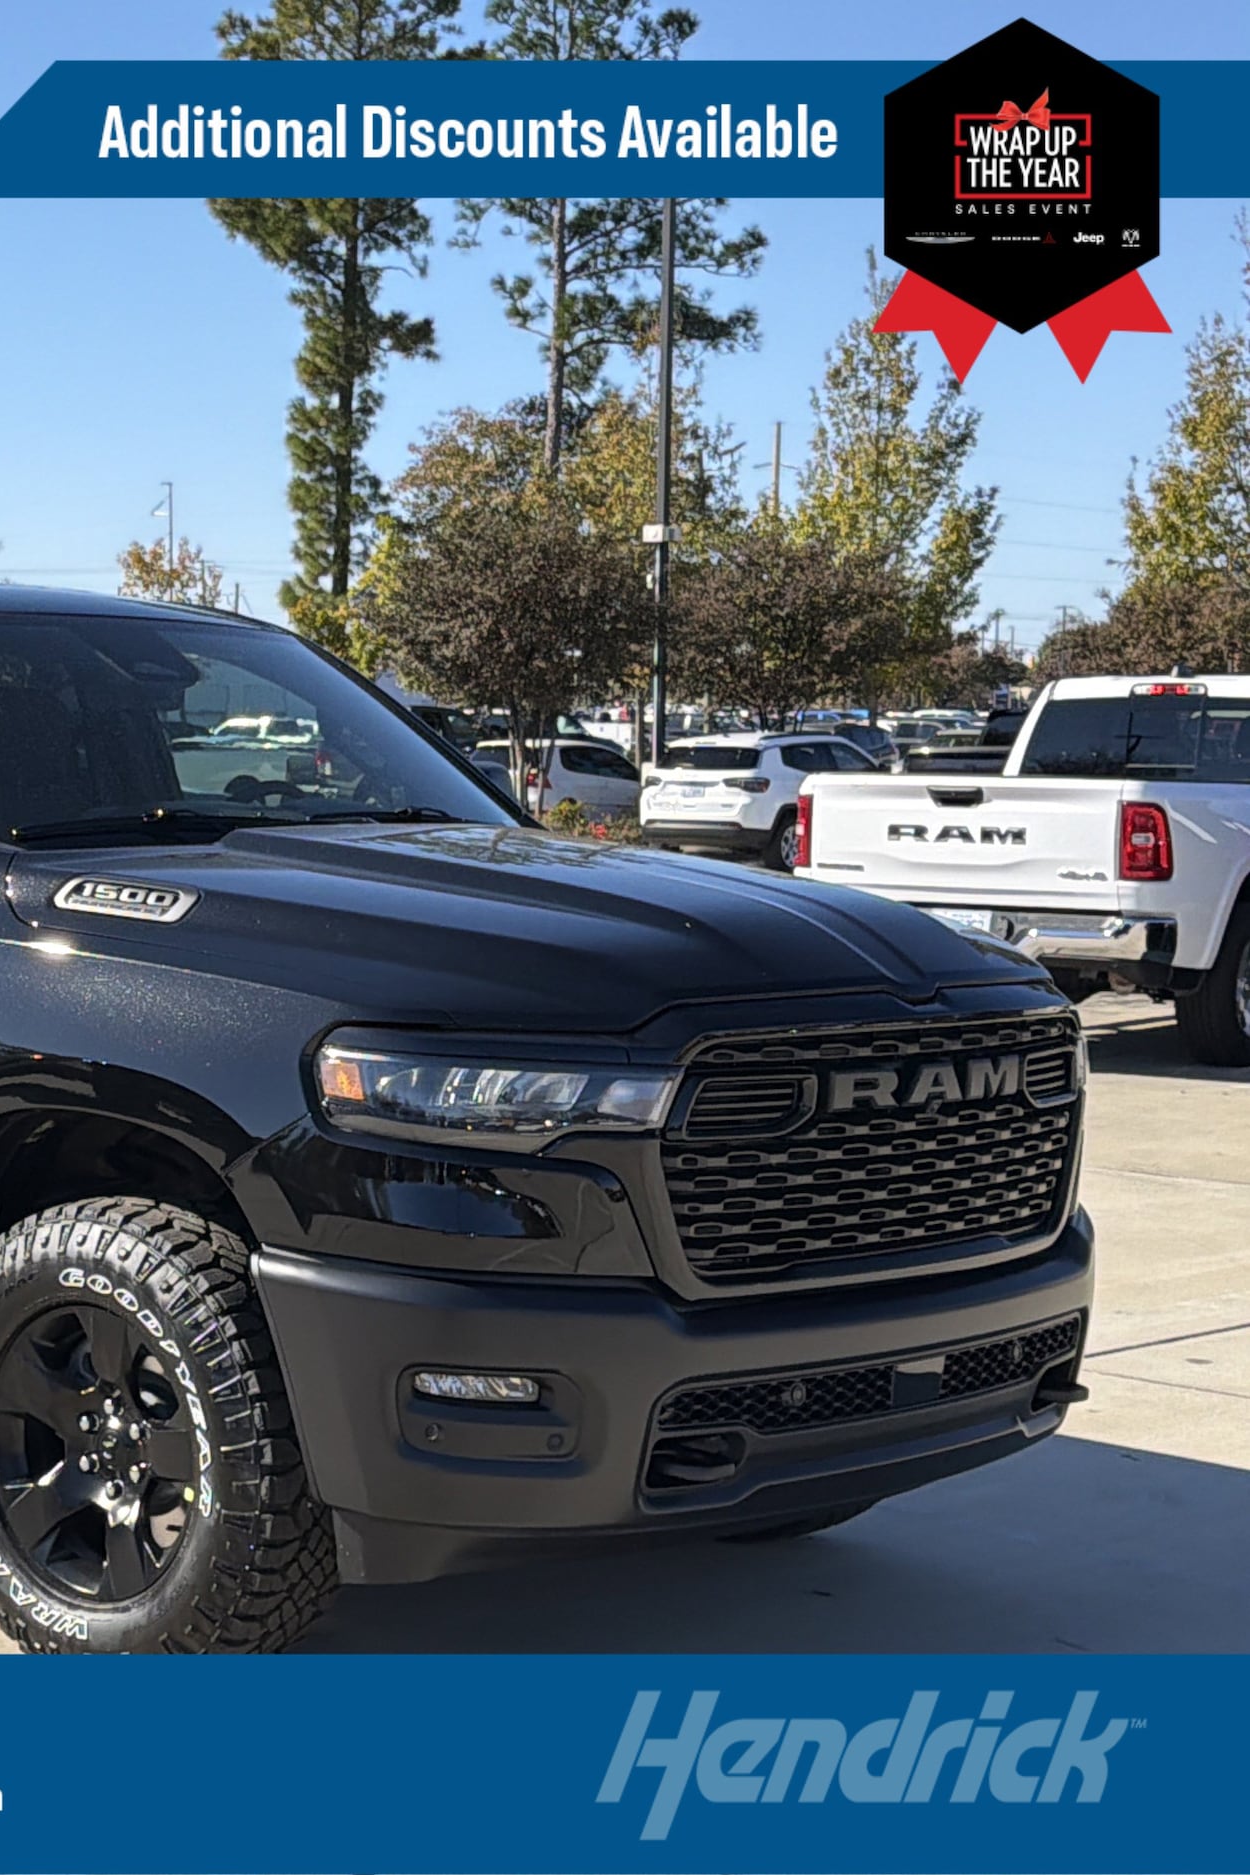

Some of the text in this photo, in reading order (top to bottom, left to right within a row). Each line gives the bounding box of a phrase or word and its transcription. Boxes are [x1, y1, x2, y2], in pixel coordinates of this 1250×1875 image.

[887, 823, 1027, 845] RAM
[82, 882, 175, 906] 1500
[828, 1053, 1021, 1113] RAM
[58, 1267, 213, 1519] GOODYEAR
